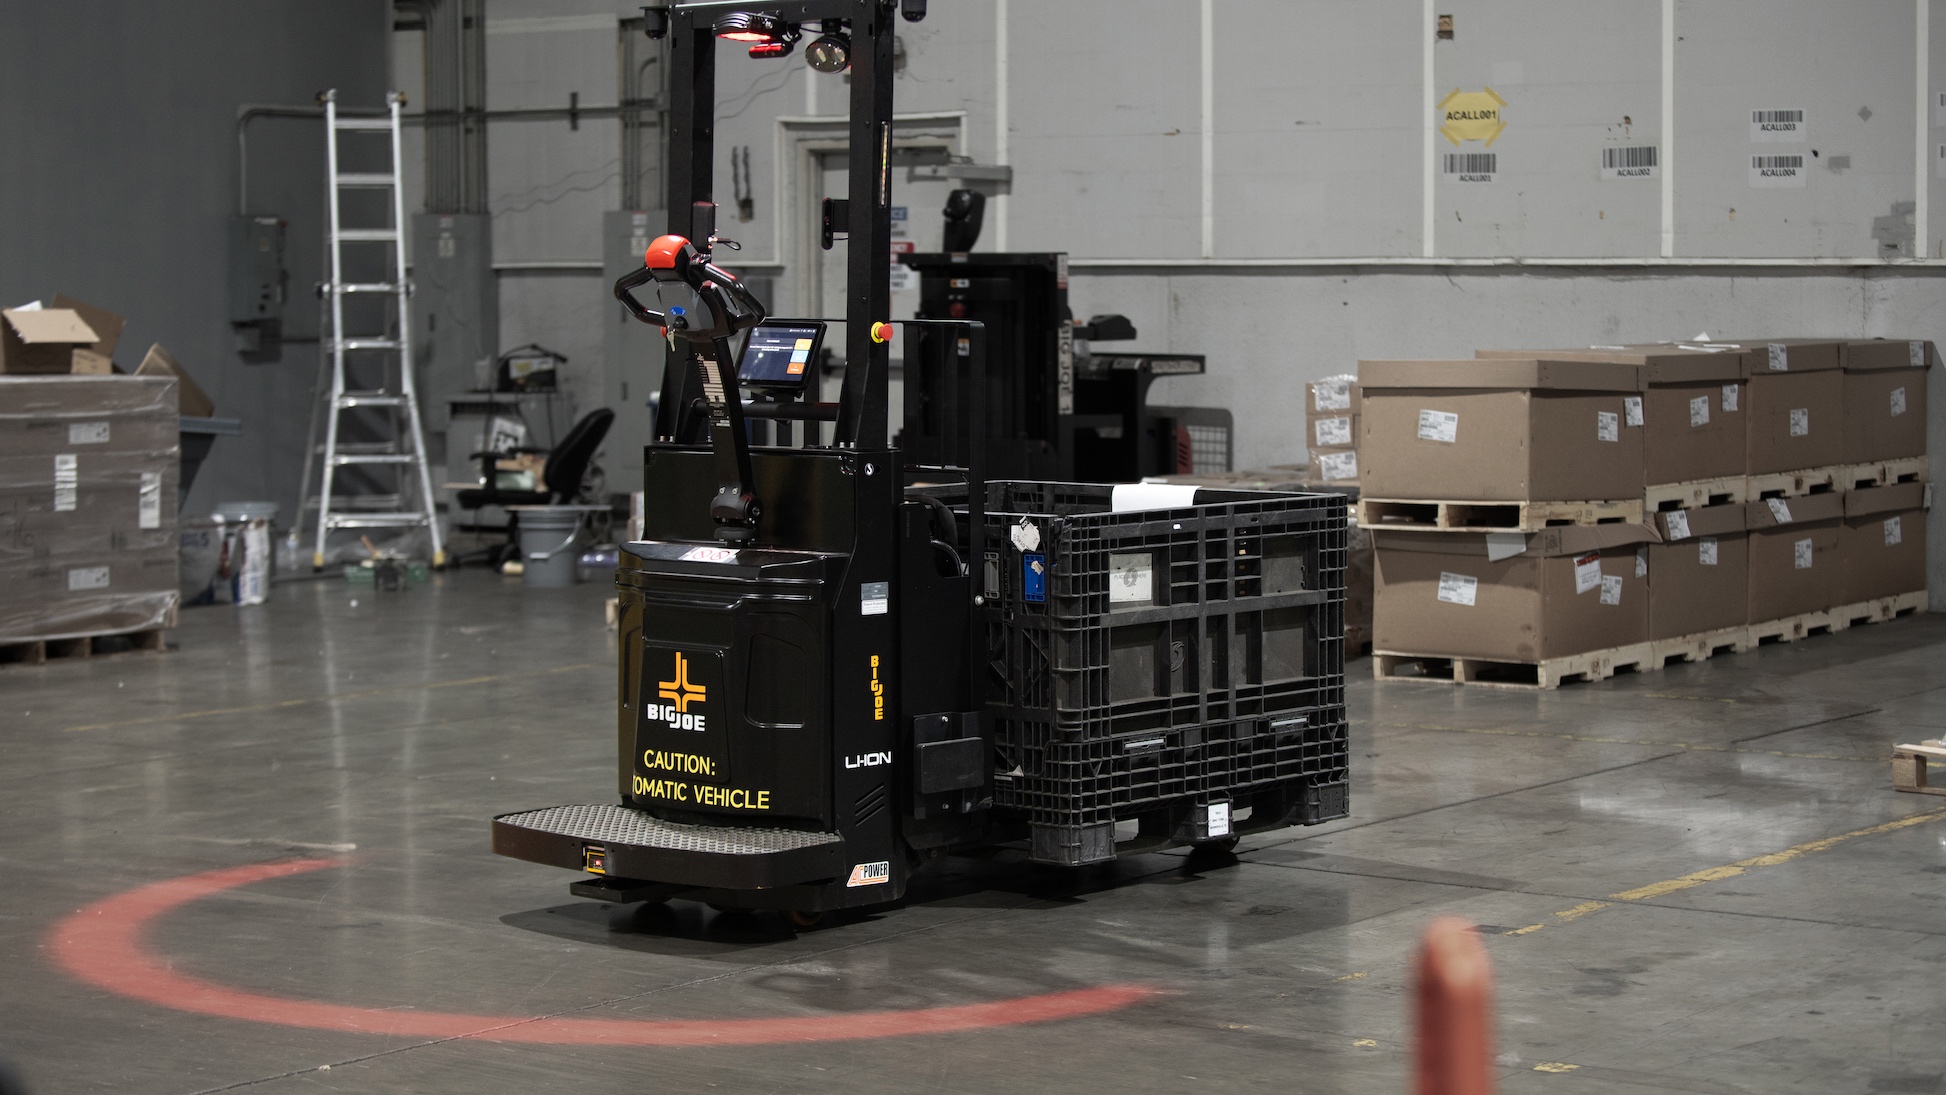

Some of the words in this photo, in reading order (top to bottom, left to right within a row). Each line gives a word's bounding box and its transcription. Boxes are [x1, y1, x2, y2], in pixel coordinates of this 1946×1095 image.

[1446, 110, 1496, 121] ACALL001
[1760, 123, 1796, 131] ACALL003
[1617, 168, 1651, 177] ACALL002
[1760, 169, 1796, 177] ACALL004
[1459, 174, 1492, 182] ACALL001
[643, 749, 716, 776] CAUTION:
[693, 784, 770, 810] VEHICLE
[863, 863, 888, 878] POWER
